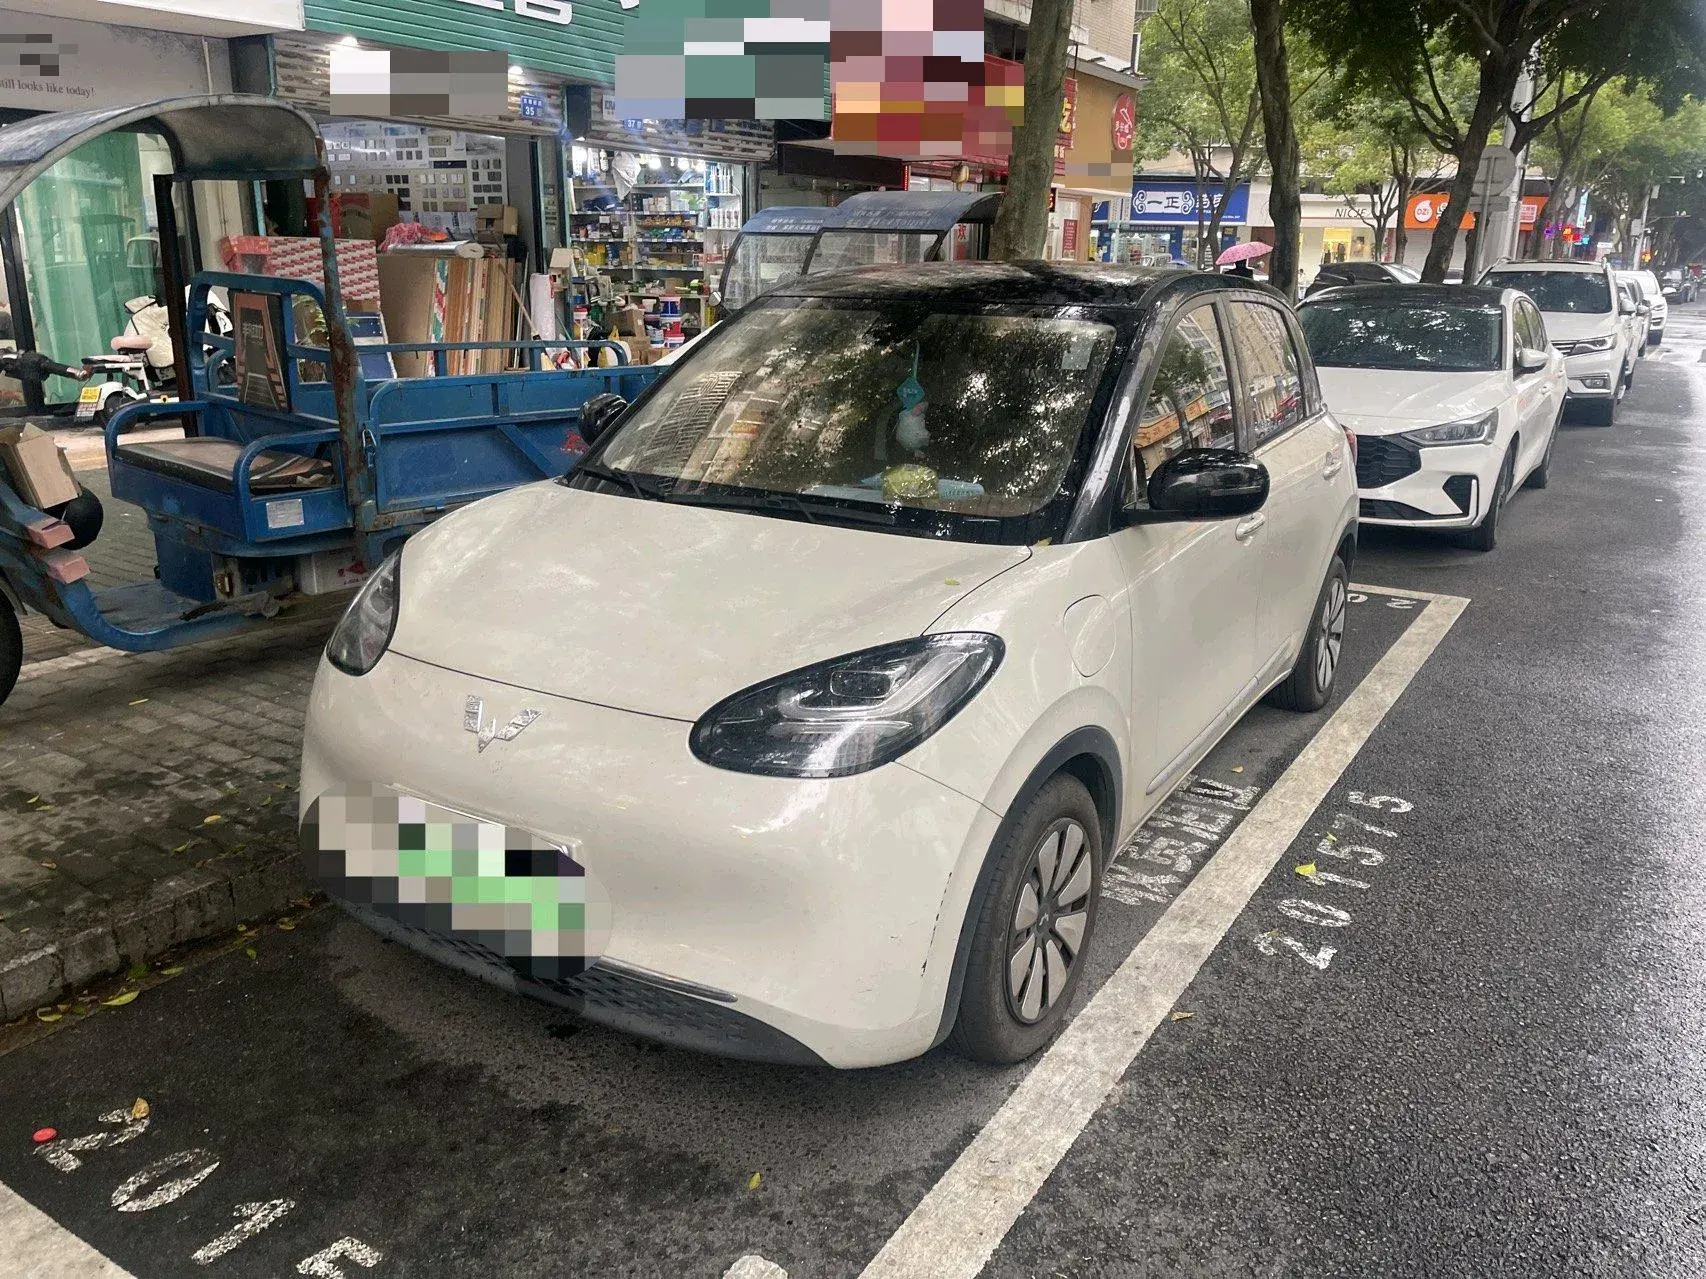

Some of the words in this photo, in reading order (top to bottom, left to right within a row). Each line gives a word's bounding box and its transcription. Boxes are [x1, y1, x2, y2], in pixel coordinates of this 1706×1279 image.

[0, 78, 15, 89] till
[17, 80, 44, 92] looks
[46, 82, 64, 94] like
[66, 86, 95, 98] today!
[525, 106, 535, 116] 35
[1254, 790, 1414, 970] 201575
